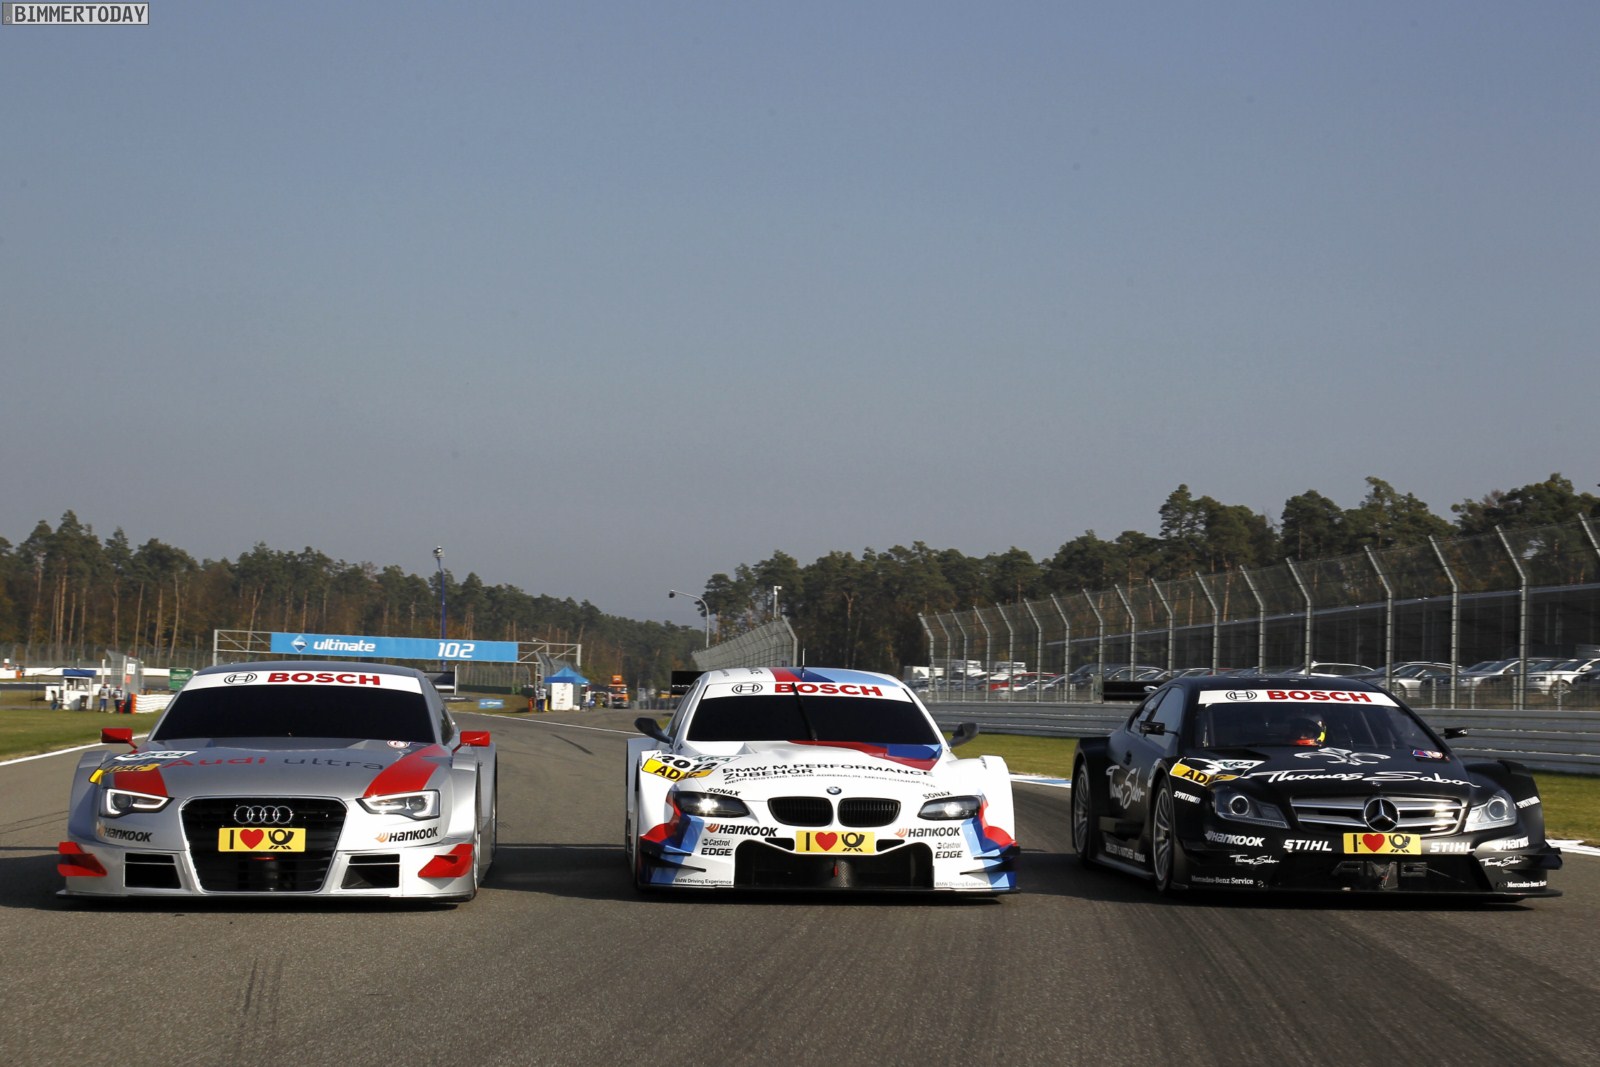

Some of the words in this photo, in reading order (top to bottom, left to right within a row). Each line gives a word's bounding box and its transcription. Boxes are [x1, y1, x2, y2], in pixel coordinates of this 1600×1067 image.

[313, 638, 376, 652] ultimate
[437, 642, 475, 659] 102
[267, 672, 381, 686] BOSCH
[775, 682, 883, 697] BOSCH
[1267, 690, 1373, 703] BOSCH
[162, 757, 267, 769] Audi
[284, 757, 384, 770] ultra
[722, 765, 767, 774] BMW
[792, 763, 934, 777] PERFORMANCE
[1245, 768, 1365, 783] Thomas
[1367, 771, 1482, 788] Sabo
[706, 787, 742, 797] SONAX
[922, 790, 953, 800] SONAX
[229, 829, 235, 850] I
[708, 838, 731, 847] Castrol
[805, 832, 811, 852] I
[942, 842, 962, 850] Castrol
[1283, 838, 1333, 853] STIHL
[700, 847, 733, 857] EDGE
[1430, 842, 1476, 853] STIHL
[934, 850, 963, 859] EDGE
[1231, 877, 1254, 885] Service
